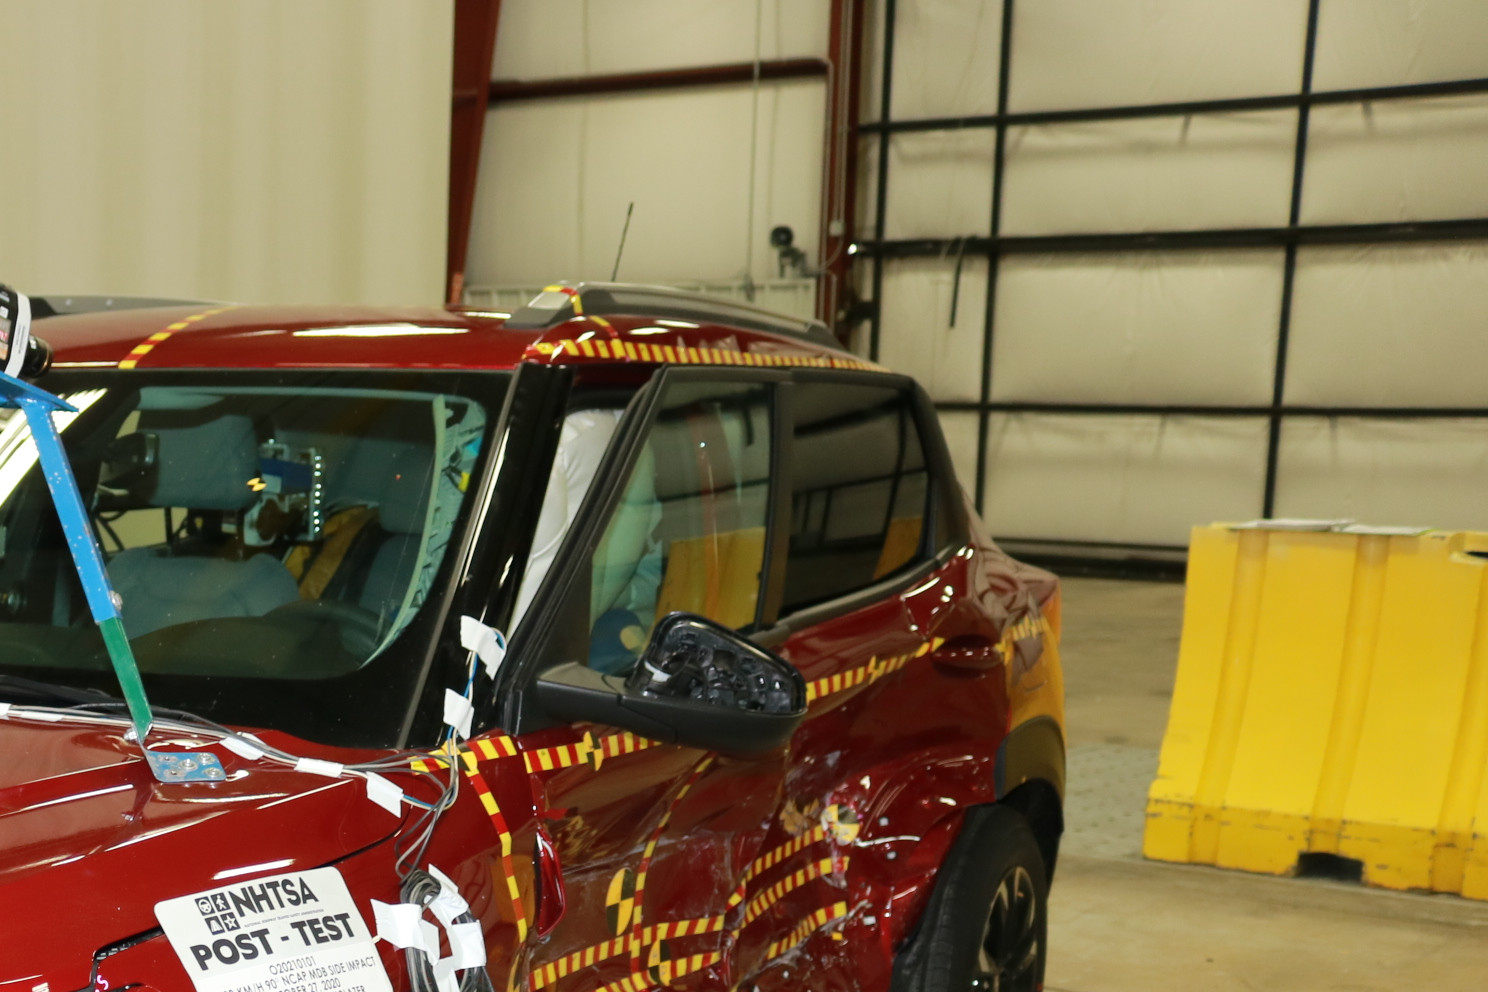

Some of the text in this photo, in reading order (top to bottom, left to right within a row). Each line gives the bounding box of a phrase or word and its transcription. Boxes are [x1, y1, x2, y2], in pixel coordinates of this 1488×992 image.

[228, 877, 319, 918] NHTSA
[190, 928, 274, 971] POST
[291, 912, 355, 946] TEST
[283, 972, 307, 987] NCAP
[311, 967, 327, 981] MDB
[328, 963, 346, 976] SIDE
[346, 956, 377, 973] IMPACT
[323, 977, 341, 991] 2020
